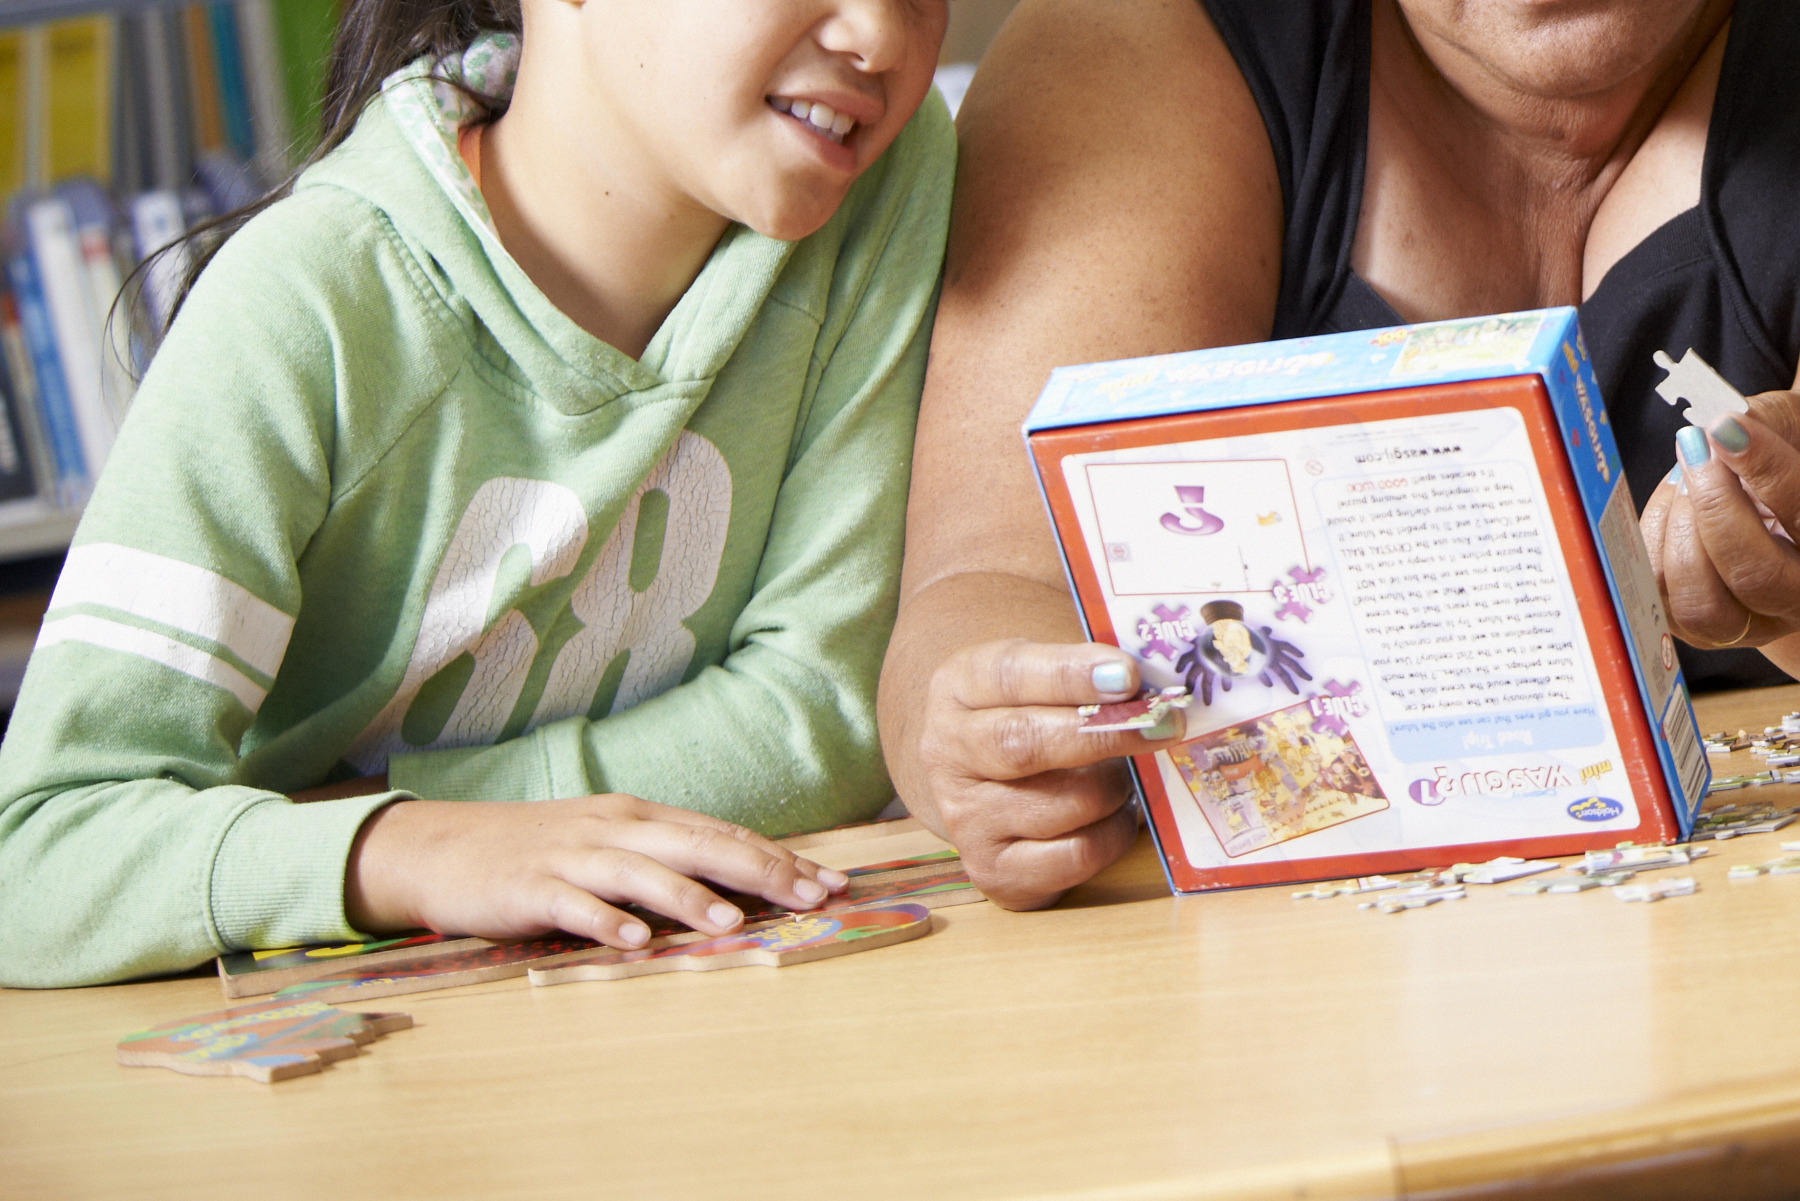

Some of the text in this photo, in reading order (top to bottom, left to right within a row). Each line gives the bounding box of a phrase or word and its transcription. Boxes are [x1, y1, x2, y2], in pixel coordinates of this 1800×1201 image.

[1355, 445, 1462, 463] www.wasgij.com
[1440, 471, 1478, 482] decades
[1377, 478, 1408, 489] GOOD
[1492, 482, 1514, 493] help
[1410, 492, 1429, 501] this
[1430, 486, 1479, 498] completing
[1369, 494, 1407, 504] amusing
[1517, 495, 1532, 505] you
[1434, 503, 1453, 513] your
[1469, 501, 1495, 510] these
[1395, 508, 1430, 518] starting
[1325, 515, 1355, 526] should
[1514, 515, 1531, 524] and
[1396, 522, 1428, 536] predict
[1454, 520, 1471, 530] and
[1377, 528, 1394, 537] the
[1509, 528, 1539, 541] puzzle
[1414, 541, 1430, 550] the
[1451, 537, 1472, 546] Also
[1340, 547, 1366, 558] BALL
[1368, 543, 1413, 555] CRYSTAL
[1494, 546, 1524, 558] puzzle
[1525, 546, 1543, 555] the
[1376, 560, 1395, 569] clue
[1405, 556, 1435, 567] simply
[1346, 564, 1363, 573] the
[1472, 565, 1488, 575] you
[1491, 562, 1523, 574] picture
[1524, 562, 1542, 572] The
[1421, 572, 1437, 581] the
[1453, 569, 1469, 577] see
[1354, 578, 1376, 588] NOT
[1388, 576, 1400, 585] lid
[1402, 574, 1420, 583] box
[1514, 579, 1537, 588] have
[1539, 575, 1555, 585] you
[1271, 580, 1331, 603] CLUE 3
[1407, 590, 1423, 599] the
[1425, 589, 1439, 598] will
[1441, 586, 1467, 596] What
[1351, 595, 1377, 605] hold?
[1378, 592, 1405, 601] future
[1513, 594, 1551, 606] changed
[342, 428, 733, 776] 68
[1473, 600, 1489, 609] the
[1491, 598, 1510, 606] over
[1364, 609, 1390, 618] scene
[1393, 608, 1409, 617] the
[1422, 605, 1441, 614] that
[1523, 610, 1562, 619] discover
[1456, 617, 1471, 627] Try
[1505, 614, 1521, 623] the
[1136, 619, 1194, 640] CLUE 2
[1383, 625, 1405, 635] what
[1407, 620, 1443, 631] imagine
[1364, 627, 1382, 635] has
[1503, 626, 1555, 639] imagination
[1434, 634, 1454, 644] your
[1470, 633, 1487, 643] well
[1392, 638, 1431, 649] curiosity
[1529, 644, 1543, 653] will
[1545, 641, 1574, 651] better
[1476, 649, 1492, 658] the
[1371, 656, 1391, 666] your
[1393, 656, 1412, 665] Use
[1474, 665, 1489, 674] the
[1380, 673, 1405, 683] much
[1407, 671, 1428, 679] How
[1553, 673, 1574, 682] How
[1468, 682, 1484, 690] the
[1485, 679, 1512, 689] would
[1514, 675, 1552, 687] different
[1418, 686, 1438, 695] look
[1439, 683, 1465, 691] scene
[1389, 689, 1405, 698] the
[1501, 692, 1544, 704] obviously
[1546, 689, 1569, 699] They
[1309, 695, 1365, 717] CLUE 1
[1437, 699, 1463, 710] lovely
[1465, 698, 1482, 707] the
[1483, 697, 1500, 705] like
[1420, 702, 1435, 712] red
[1553, 707, 1570, 716] you
[1572, 707, 1596, 716] Have
[1493, 715, 1512, 724] that
[1513, 711, 1535, 720] eyes
[1536, 709, 1552, 720] got
[1387, 723, 1419, 733] future?
[1420, 721, 1436, 730] the
[1437, 720, 1455, 729] into
[1496, 729, 1534, 746] Road
[1578, 759, 1612, 784] mini
